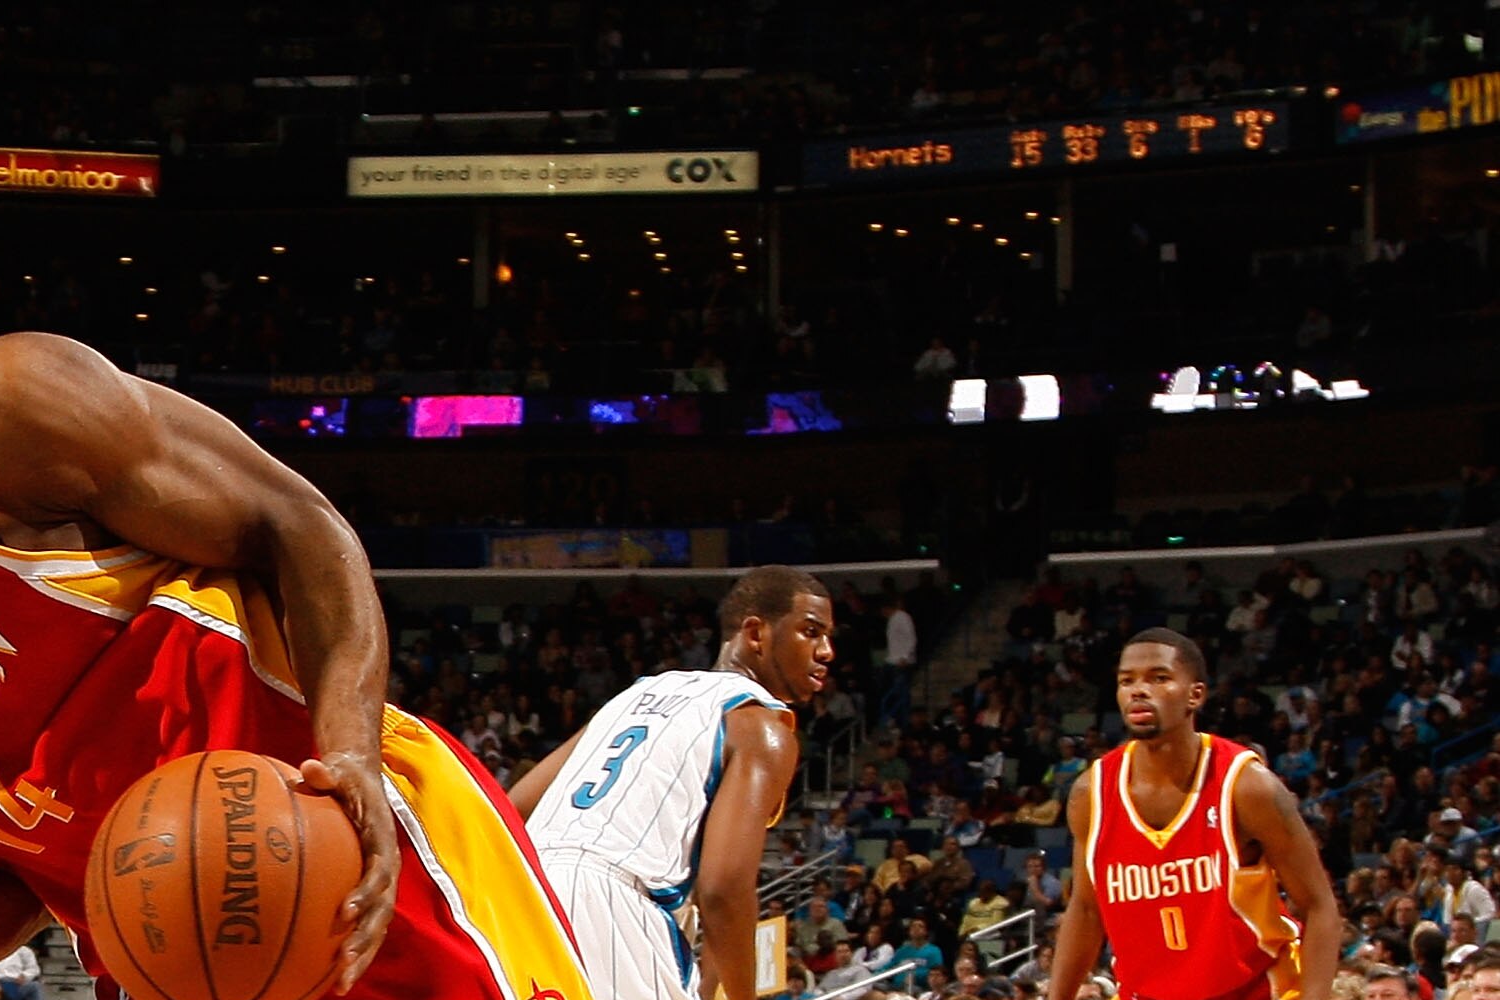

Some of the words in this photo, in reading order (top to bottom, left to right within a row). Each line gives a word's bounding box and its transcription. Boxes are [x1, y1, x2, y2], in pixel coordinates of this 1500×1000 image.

[666, 157, 737, 183] COX
[848, 140, 953, 170] Hornets
[361, 169, 406, 187] your
[412, 164, 471, 181] friend
[477, 165, 494, 181] in
[500, 165, 530, 180] the
[605, 167, 641, 183] age
[319, 376, 375, 393] CLUB
[571, 725, 648, 809] 3
[211, 765, 261, 950] SPALDING
[1106, 849, 1222, 904] HOUSTON
[1160, 906, 1188, 951] 0
